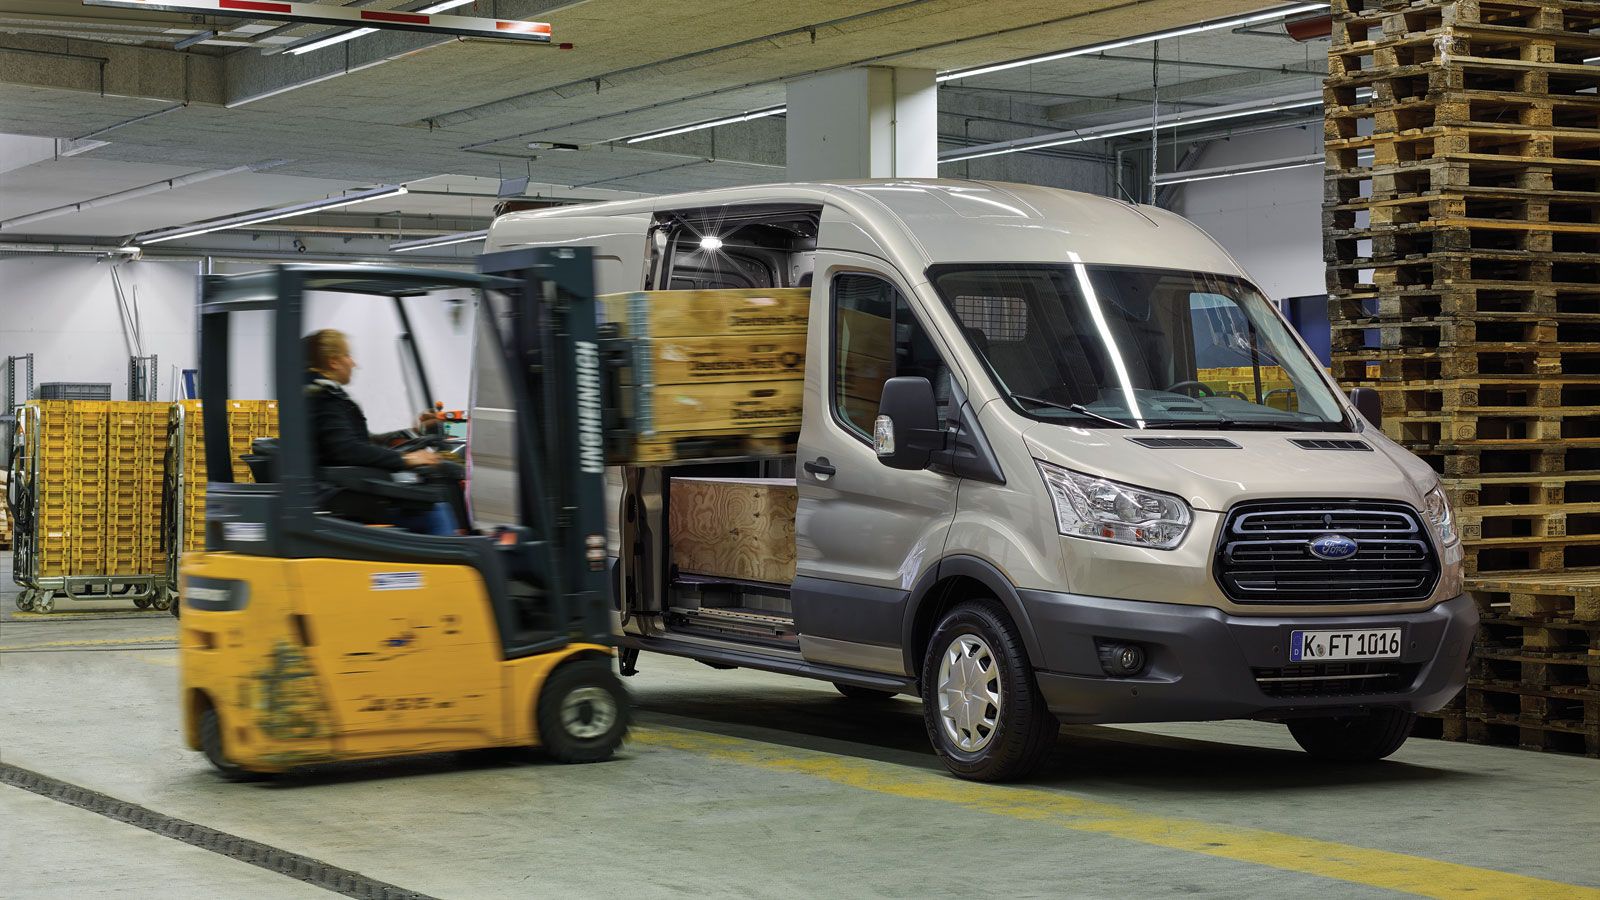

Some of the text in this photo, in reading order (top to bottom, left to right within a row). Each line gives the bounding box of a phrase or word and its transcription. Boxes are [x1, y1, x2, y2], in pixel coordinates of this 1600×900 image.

[1322, 540, 1349, 555] Ford
[1303, 632, 1399, 656] K FT 1016
